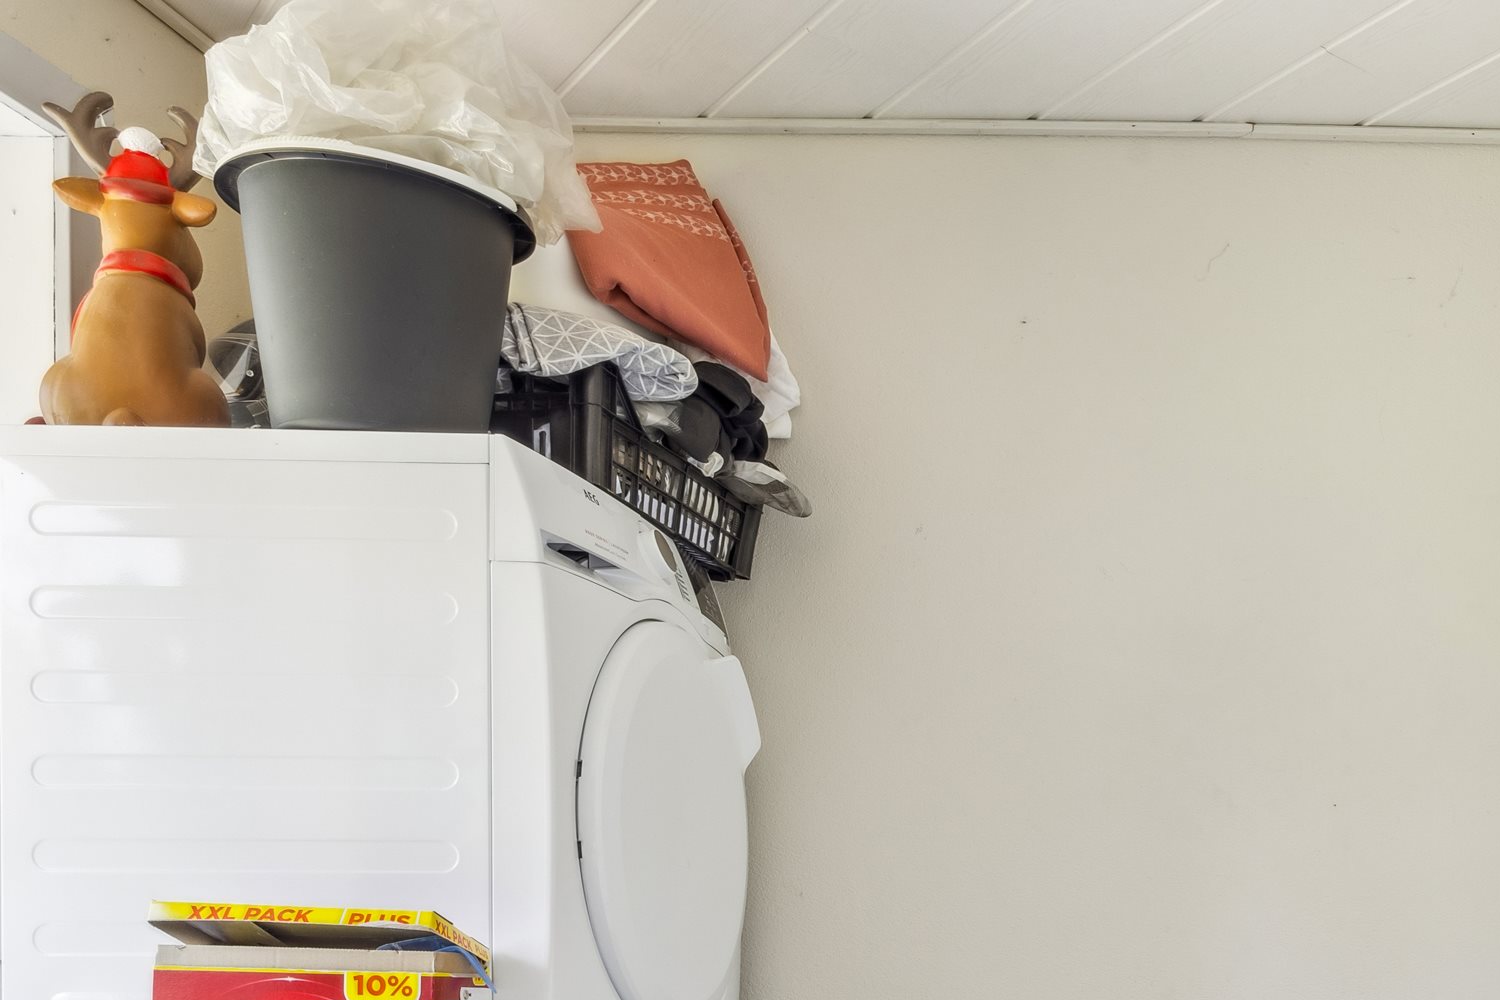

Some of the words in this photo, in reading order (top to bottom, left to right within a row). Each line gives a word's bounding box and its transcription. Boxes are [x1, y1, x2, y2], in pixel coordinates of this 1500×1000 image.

[188, 905, 236, 921] XXL
[243, 907, 314, 923] PACK
[435, 919, 451, 939] XXL
[452, 930, 472, 952] PACK
[352, 975, 413, 997] 10%
